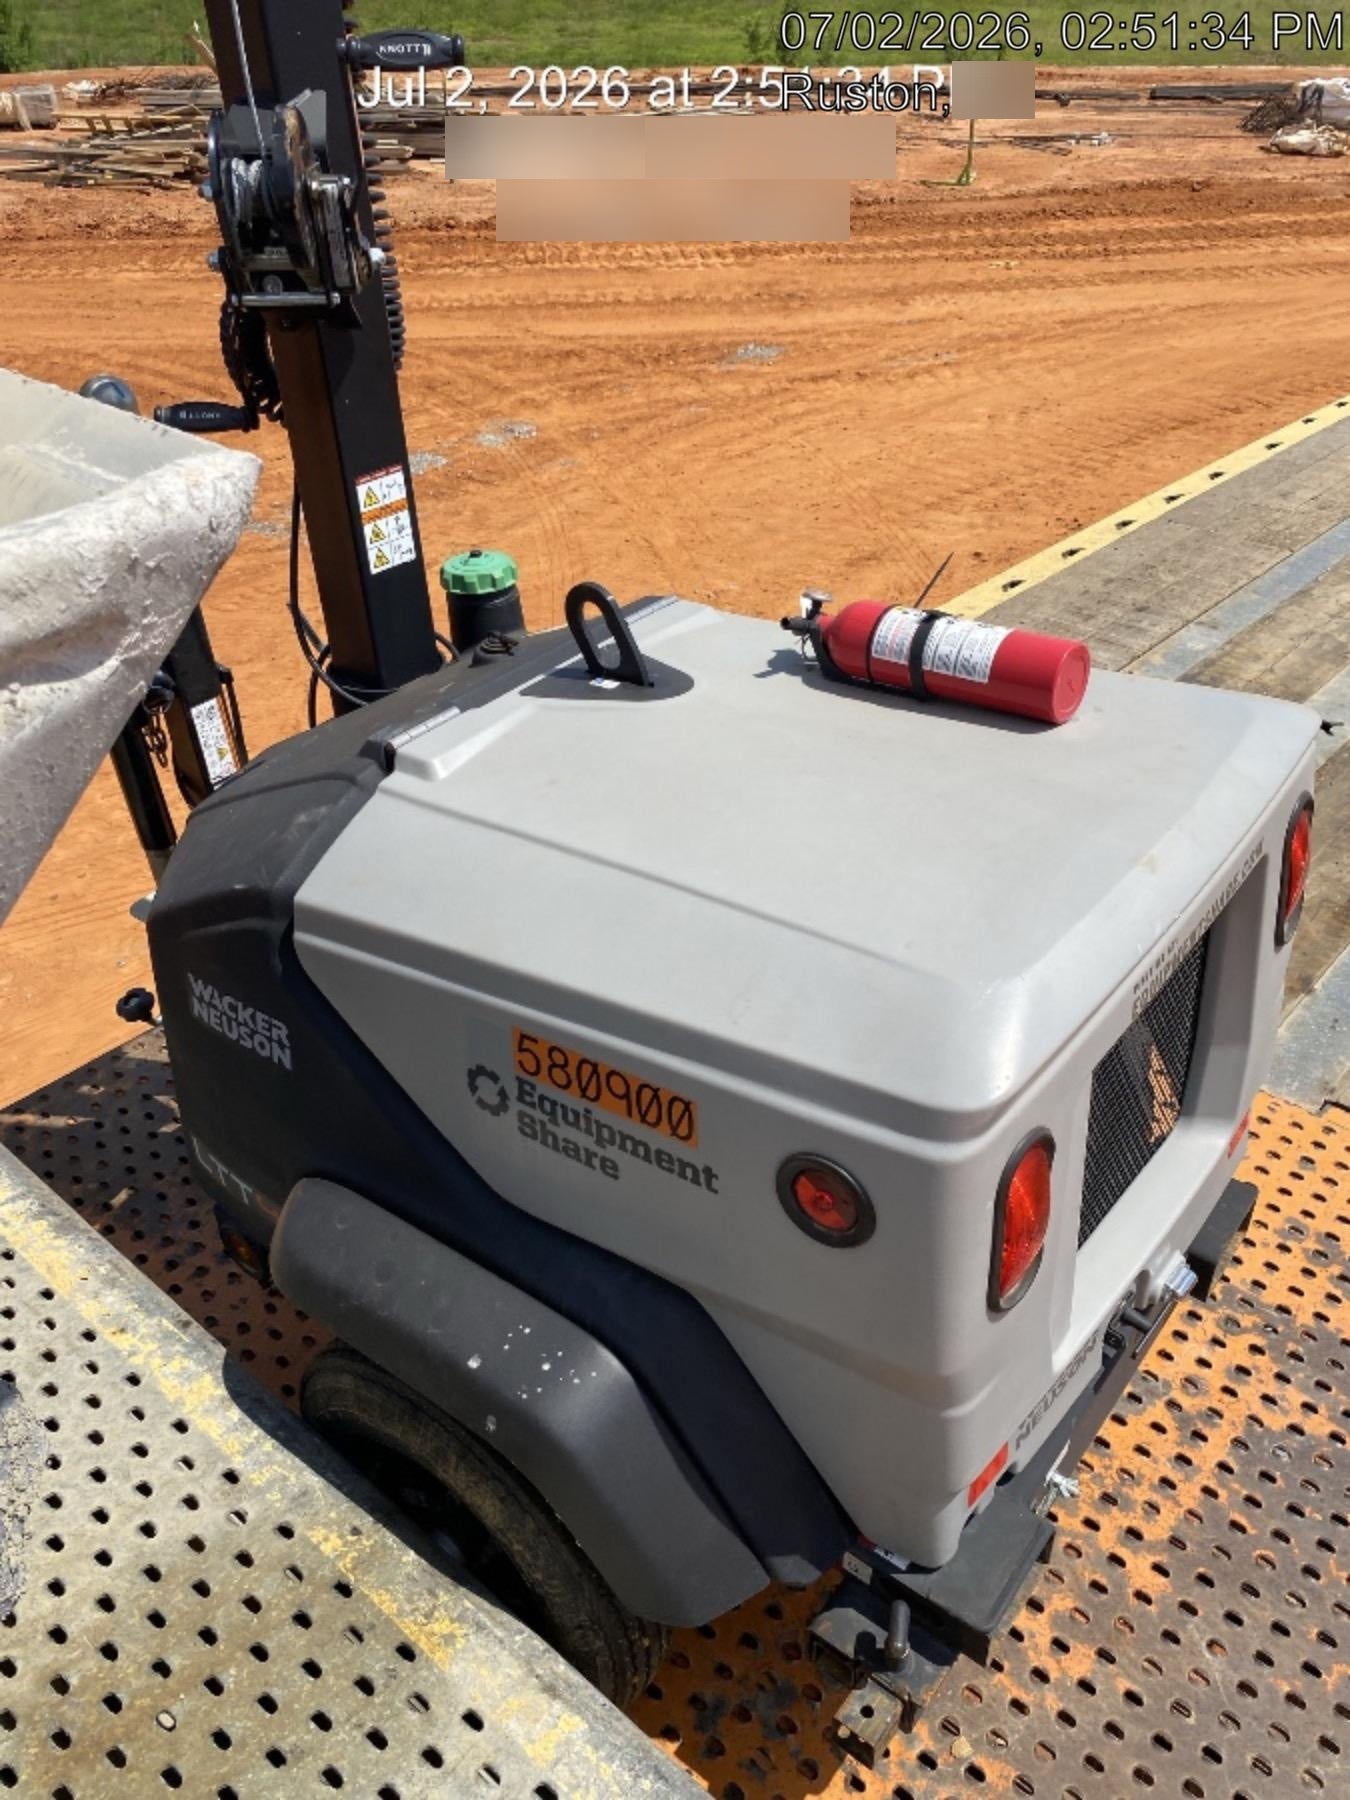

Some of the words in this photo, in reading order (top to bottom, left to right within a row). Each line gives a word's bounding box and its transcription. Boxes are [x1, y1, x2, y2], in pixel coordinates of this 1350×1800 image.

[378, 43, 423, 54] KNOTT
[187, 972, 291, 1047] WACKER
[191, 998, 293, 1071] NEUSON
[516, 1033, 697, 1142] 580900
[515, 1075, 720, 1195] Equipment
[516, 1109, 621, 1182] Share
